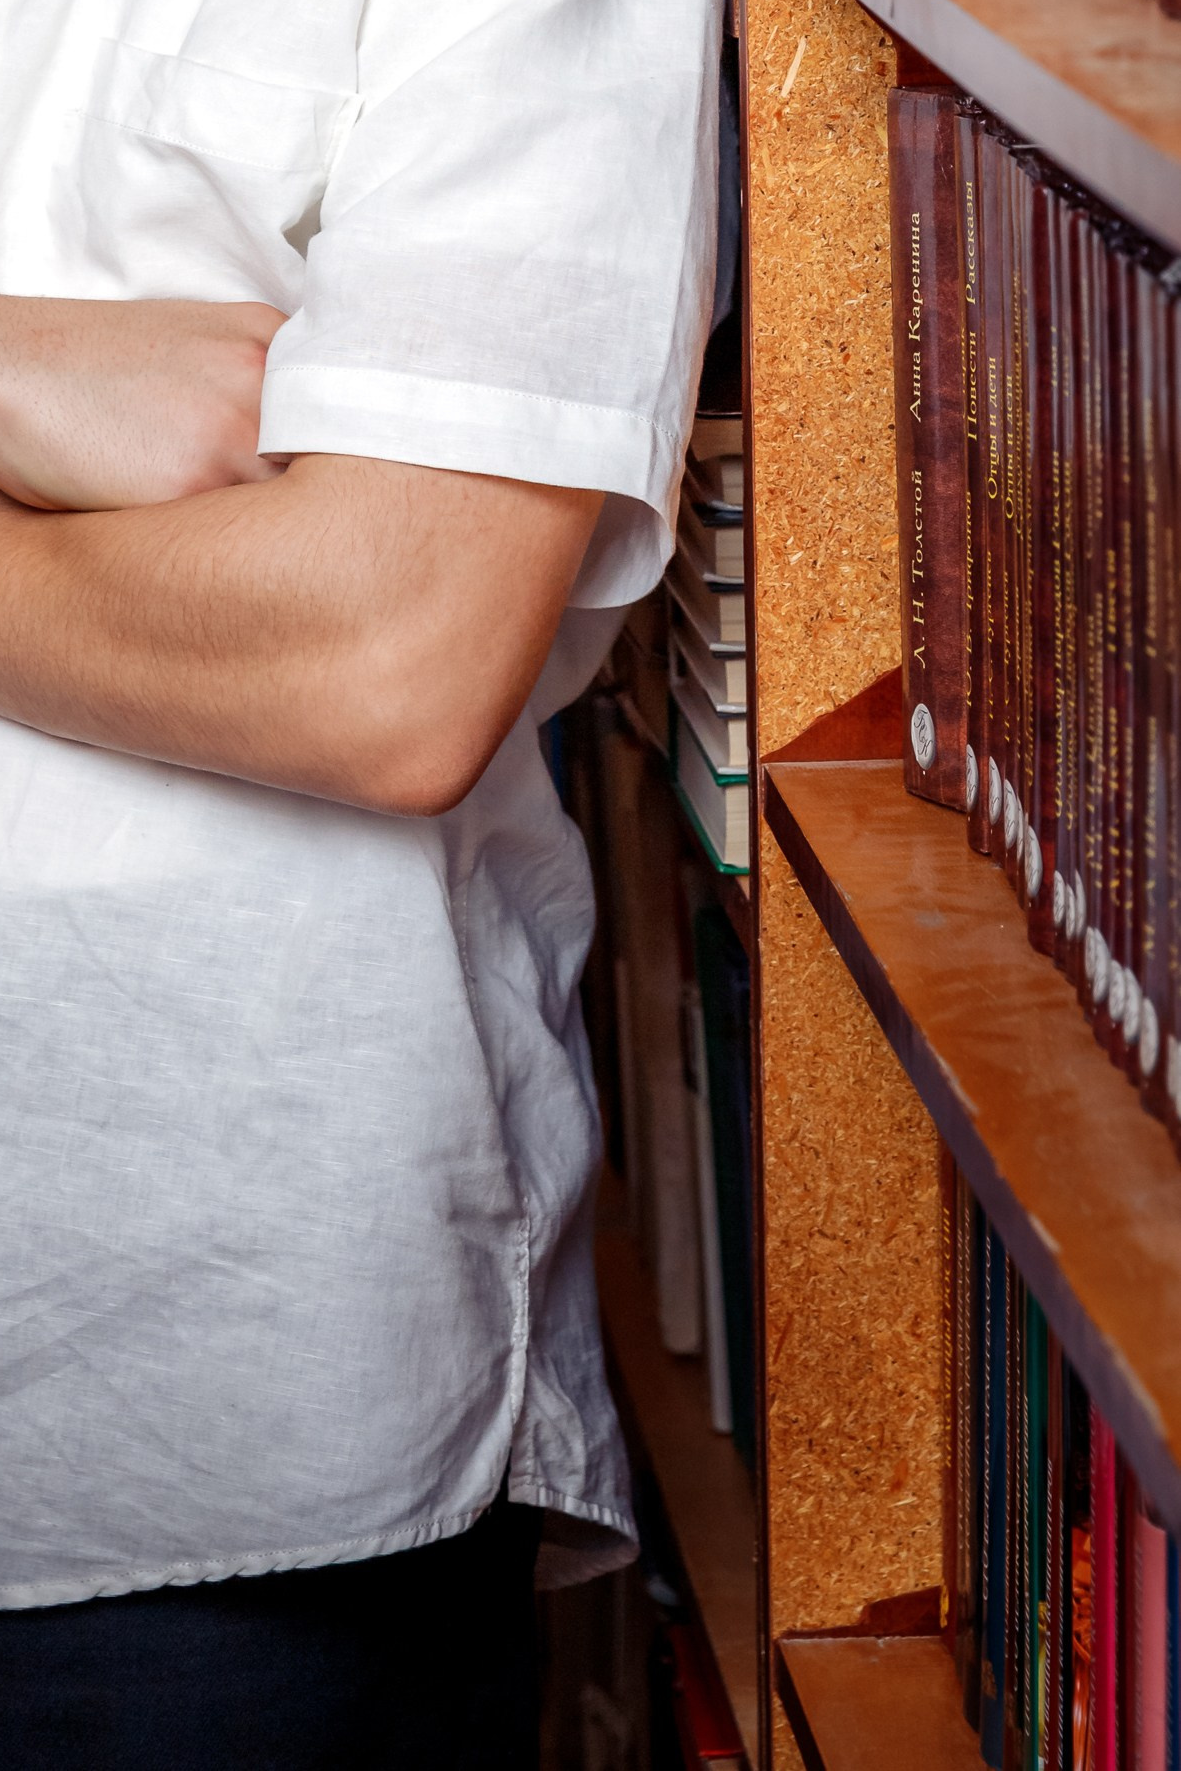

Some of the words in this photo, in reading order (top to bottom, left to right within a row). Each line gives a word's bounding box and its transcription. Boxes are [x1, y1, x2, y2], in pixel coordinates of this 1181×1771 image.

[908, 211, 923, 343] Каренина
[964, 181, 976, 306] Рассказы
[909, 351, 921, 424] Анна
[966, 331, 977, 442] Повести
[988, 356, 998, 409] дети
[911, 469, 924, 584] Толстой
[912, 591, 925, 626] Н.
[914, 636, 926, 670] Л.
